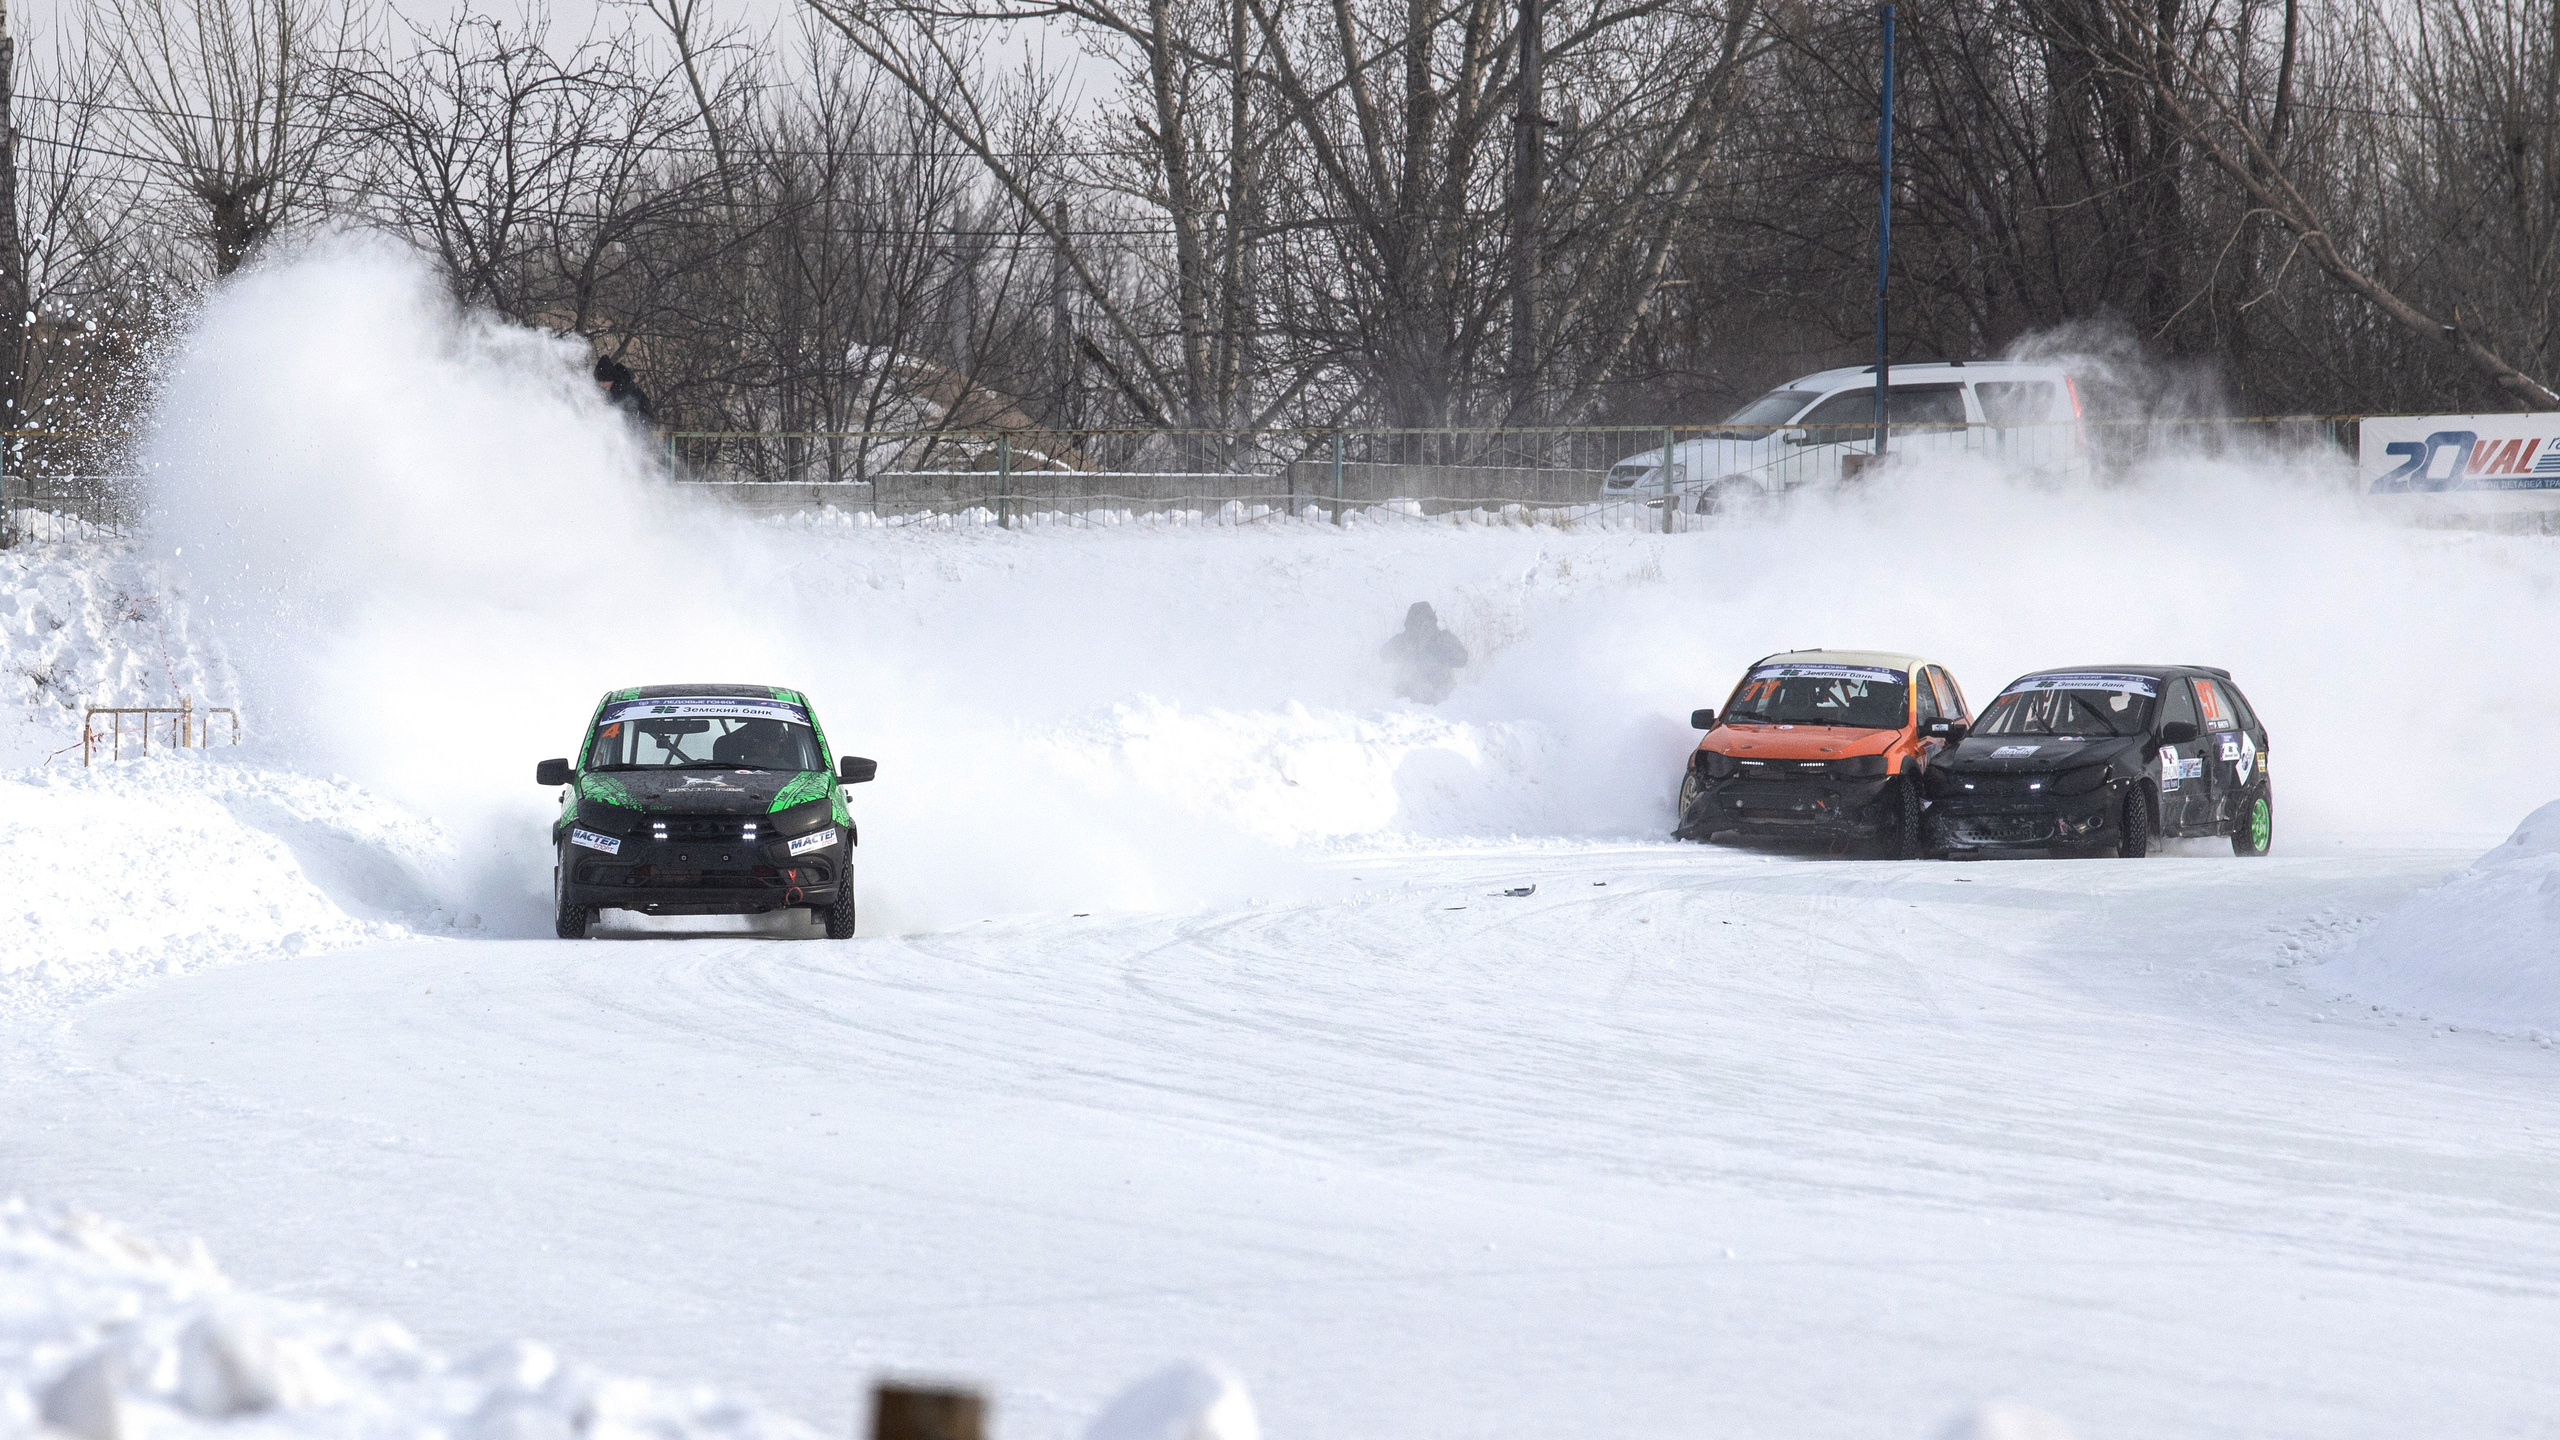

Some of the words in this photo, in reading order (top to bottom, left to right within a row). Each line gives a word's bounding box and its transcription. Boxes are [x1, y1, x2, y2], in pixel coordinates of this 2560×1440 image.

[2501, 479, 2542, 489] ДЕТАЛЕЙ
[2197, 681, 2219, 718] 97
[683, 706, 739, 714] Земский
[742, 707, 773, 715] банк
[601, 723, 620, 738] 4
[574, 830, 619, 846] МАСТЕР
[791, 830, 835, 850] МАСТЕР
